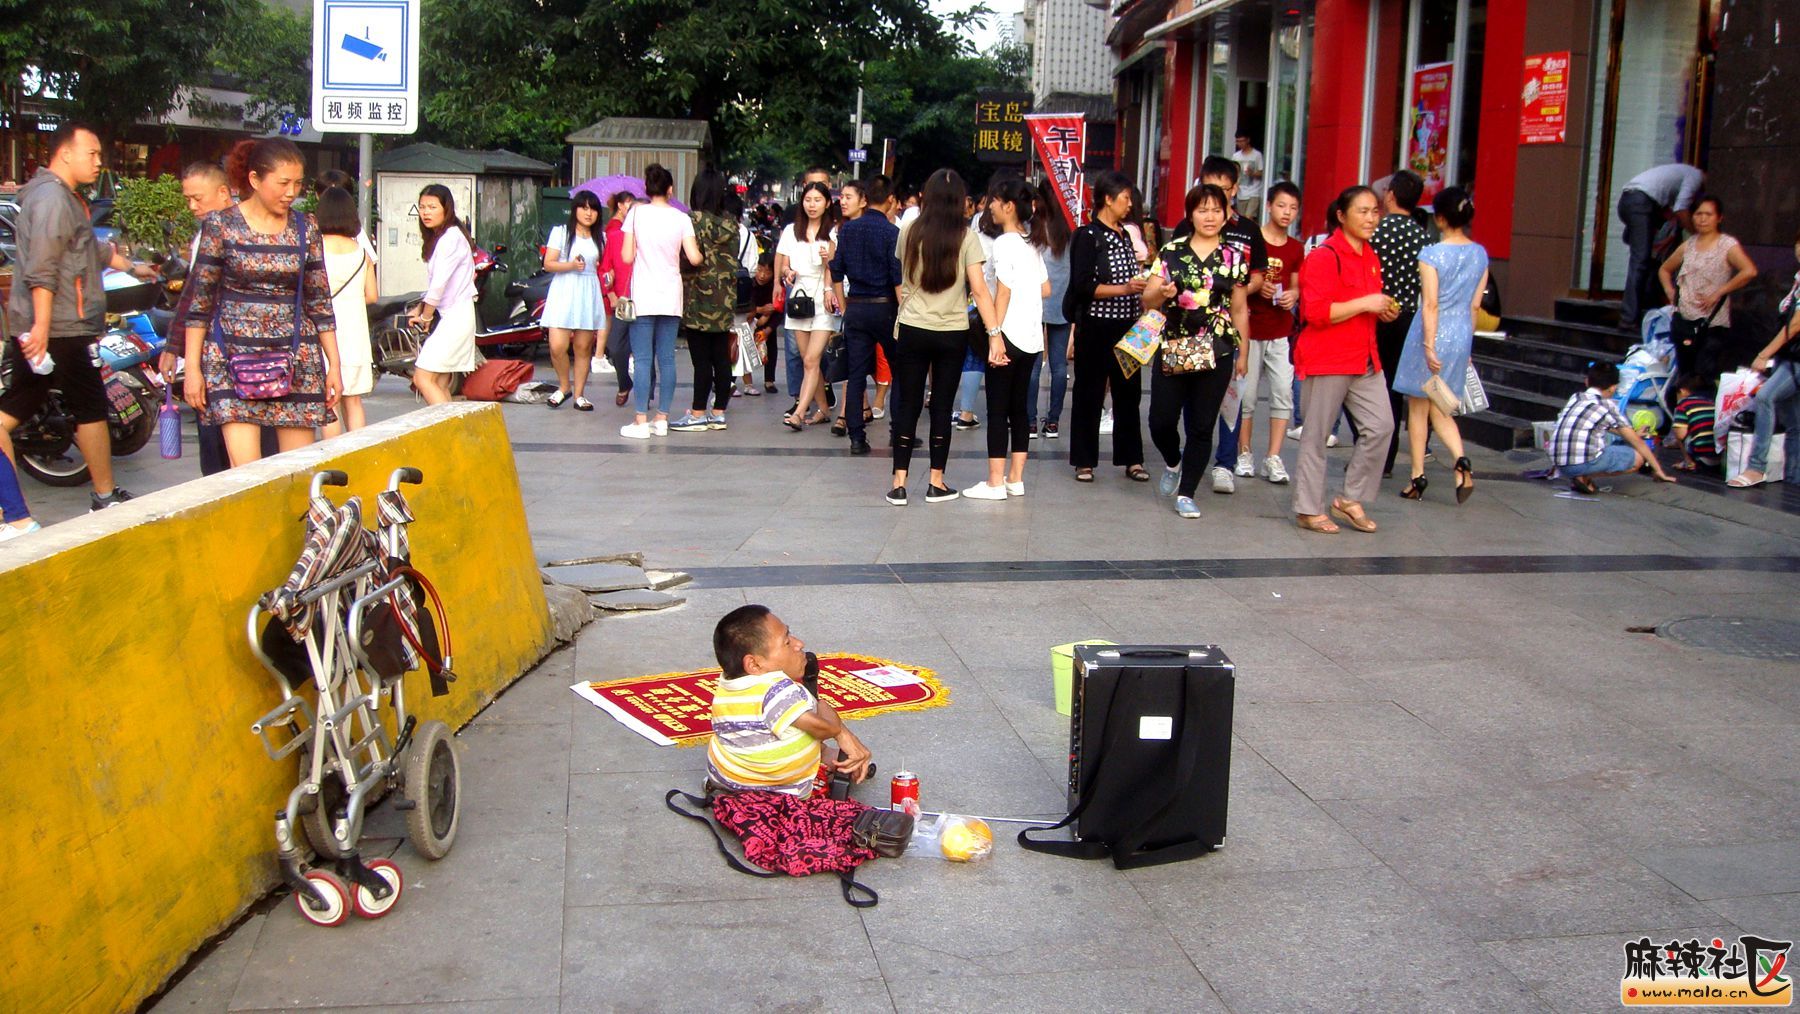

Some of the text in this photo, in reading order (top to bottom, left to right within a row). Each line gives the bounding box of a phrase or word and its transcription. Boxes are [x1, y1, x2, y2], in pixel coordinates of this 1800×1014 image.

[328, 101, 402, 120] 视频监控
[980, 101, 1023, 123] 宝岛
[979, 129, 1023, 152] 眼镜
